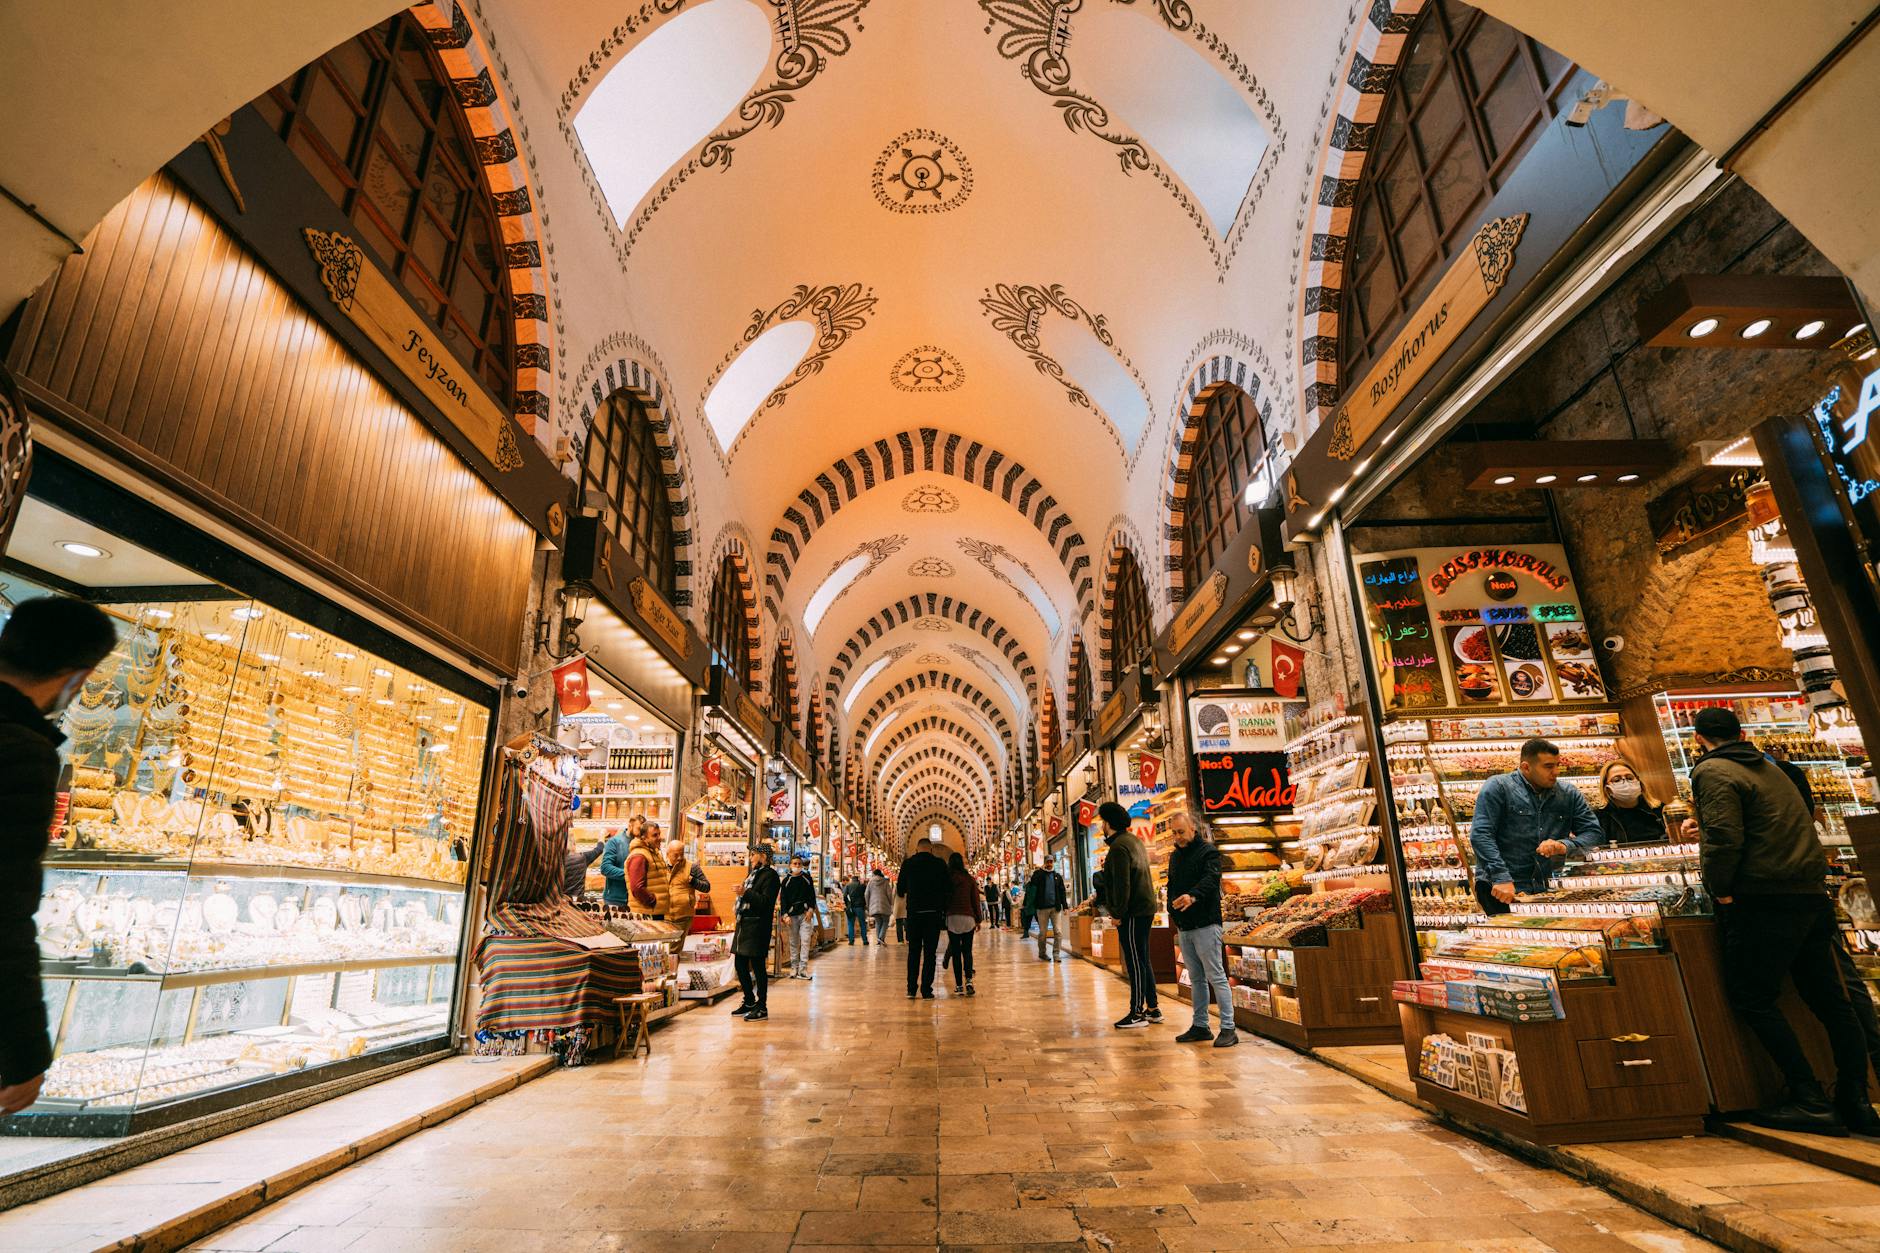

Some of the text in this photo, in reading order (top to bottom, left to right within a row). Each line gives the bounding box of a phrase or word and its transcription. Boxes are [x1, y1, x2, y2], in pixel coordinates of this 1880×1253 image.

[1370, 302, 1449, 408] Bosphorus
[401, 328, 469, 408] Feyzan
[1430, 549, 1569, 595] BOSPHORUS
[1490, 581, 1516, 590] No:4
[1439, 608, 1480, 621] SAFFRON
[1486, 606, 1529, 620] CAVIAR
[1538, 604, 1577, 618] SPICES
[1238, 717, 1276, 727] IRANIAN
[1238, 728, 1278, 737] RUSSIAN
[1200, 755, 1234, 770] No:6
